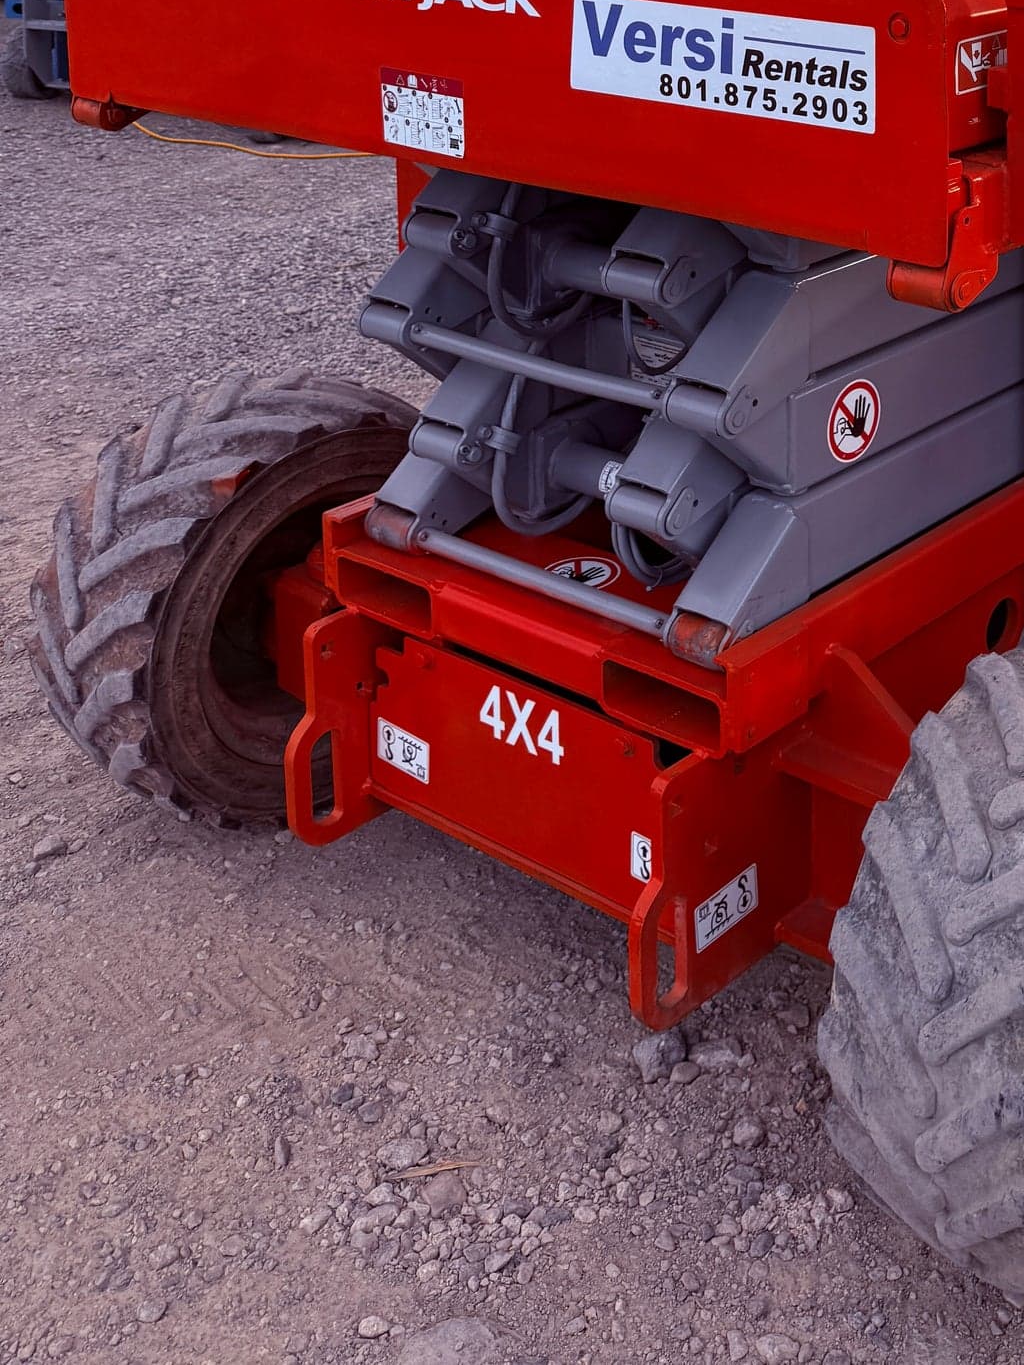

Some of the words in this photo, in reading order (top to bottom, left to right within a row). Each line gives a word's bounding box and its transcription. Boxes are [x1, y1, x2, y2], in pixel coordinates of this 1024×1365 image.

[582, 0, 734, 75] Versi
[742, 48, 868, 92] Rentals
[659, 73, 869, 126] 801.875.2903
[479, 685, 565, 766] 4X4
